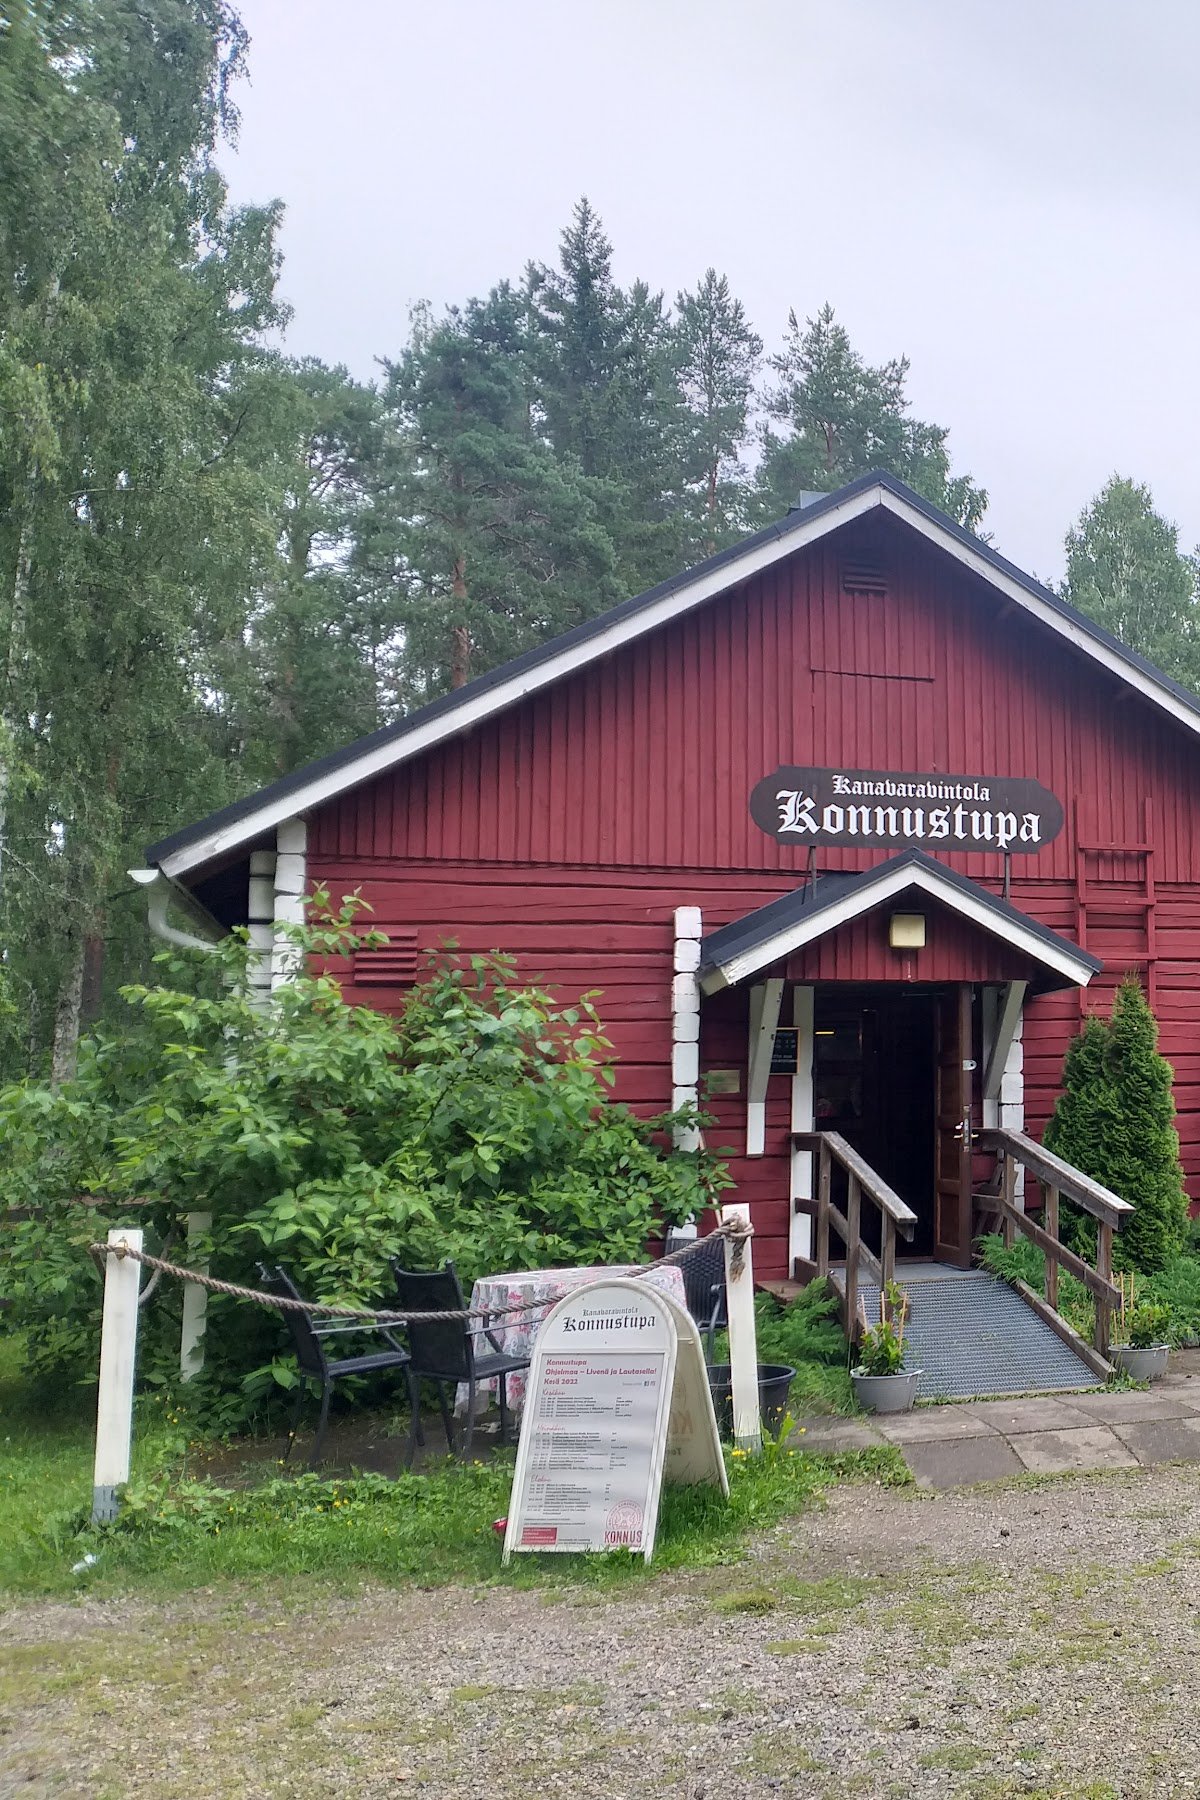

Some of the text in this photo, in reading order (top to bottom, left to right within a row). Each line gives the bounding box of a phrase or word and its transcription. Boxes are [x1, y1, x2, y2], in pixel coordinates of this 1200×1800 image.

[832, 773, 991, 802] Kanavaravintola
[775, 789, 1042, 849] Konnustupa
[562, 1315, 656, 1333] Konnustupa
[546, 1359, 588, 1367] Konnustupa
[604, 1530, 642, 1544] KONNUS
